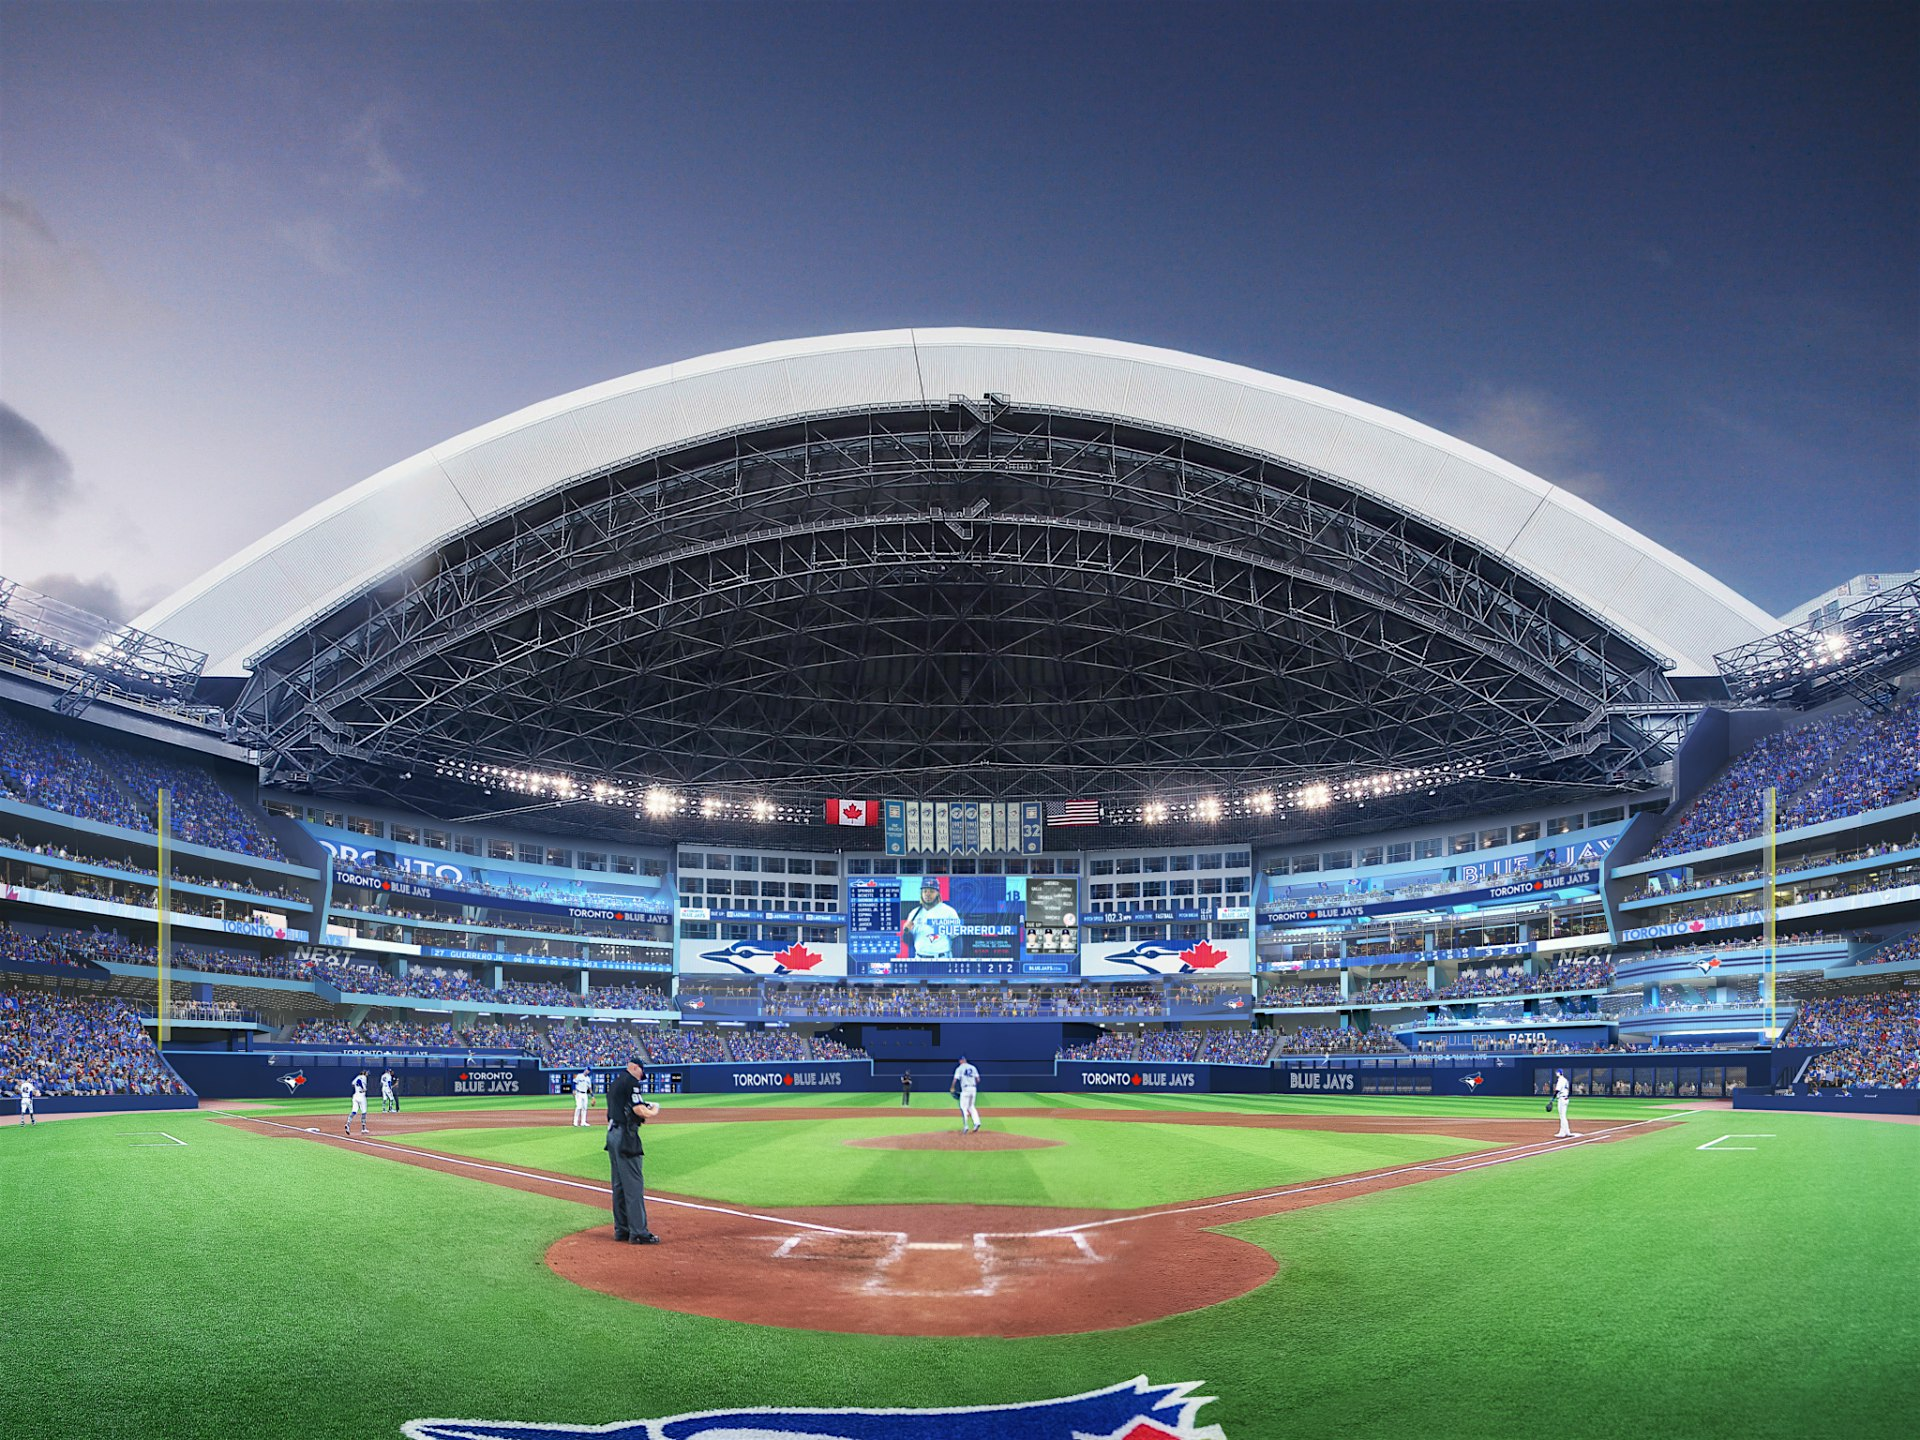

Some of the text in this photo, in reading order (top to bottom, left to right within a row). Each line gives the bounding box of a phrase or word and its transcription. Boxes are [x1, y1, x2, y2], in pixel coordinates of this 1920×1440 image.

[1023, 825, 1040, 837] 32
[336, 871, 431, 899] TORONTO BLUE JAYS
[1489, 872, 1590, 898] TORONTO BLUE JAYS
[1007, 891, 1020, 901] 1B
[569, 908, 668, 924] TORONTO BLUE JAYS
[1105, 913, 1123, 923] 102.3
[1268, 907, 1364, 922] TORONTO BLUE JAYS
[222, 919, 274, 938] TORONTO
[938, 925, 1014, 935] GUERRERO JR.
[1623, 921, 1688, 941] TORONTO
[1705, 914, 1740, 930] BLUE
[435, 948, 445, 957] 27
[450, 950, 492, 961] GUERRERO
[1485, 949, 1493, 957] 3
[1501, 947, 1509, 955] 2
[1516, 946, 1523, 954] 0
[988, 964, 1013, 973] 2 1 2
[468, 1071, 513, 1080] TORONTO
[733, 1072, 841, 1087] TORONTO BLUE JAYS
[964, 1068, 973, 1078] 42
[1081, 1072, 1195, 1087] TORONTO BLUE JAYS
[454, 1081, 519, 1092] BLUE JAYS
[1290, 1072, 1354, 1090] BLUE JAYS
